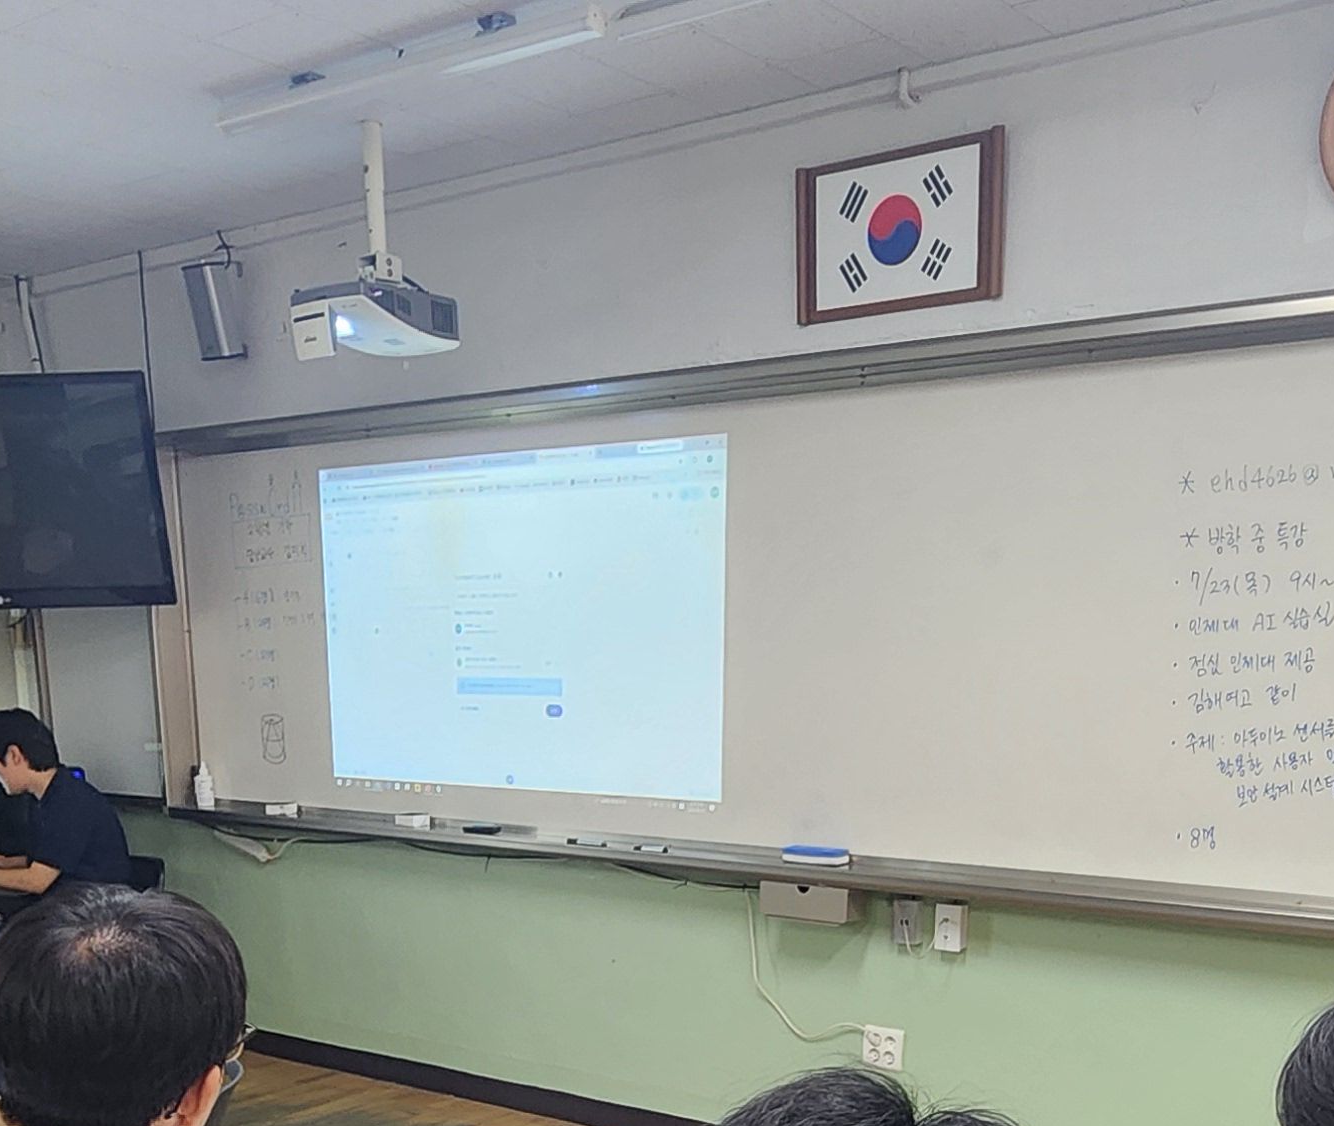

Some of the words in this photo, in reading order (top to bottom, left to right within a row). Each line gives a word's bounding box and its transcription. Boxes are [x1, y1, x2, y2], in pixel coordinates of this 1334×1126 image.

[1208, 523, 1242, 555] 방학
[1250, 523, 1265, 553] 중
[1276, 521, 1309, 551] 특강
[1188, 616, 1240, 636] 인제대
[1251, 612, 1278, 632] AI
[1283, 647, 1316, 674] 제공
[1187, 688, 1252, 714] 김해여고
[1272, 750, 1313, 771] 사용자
